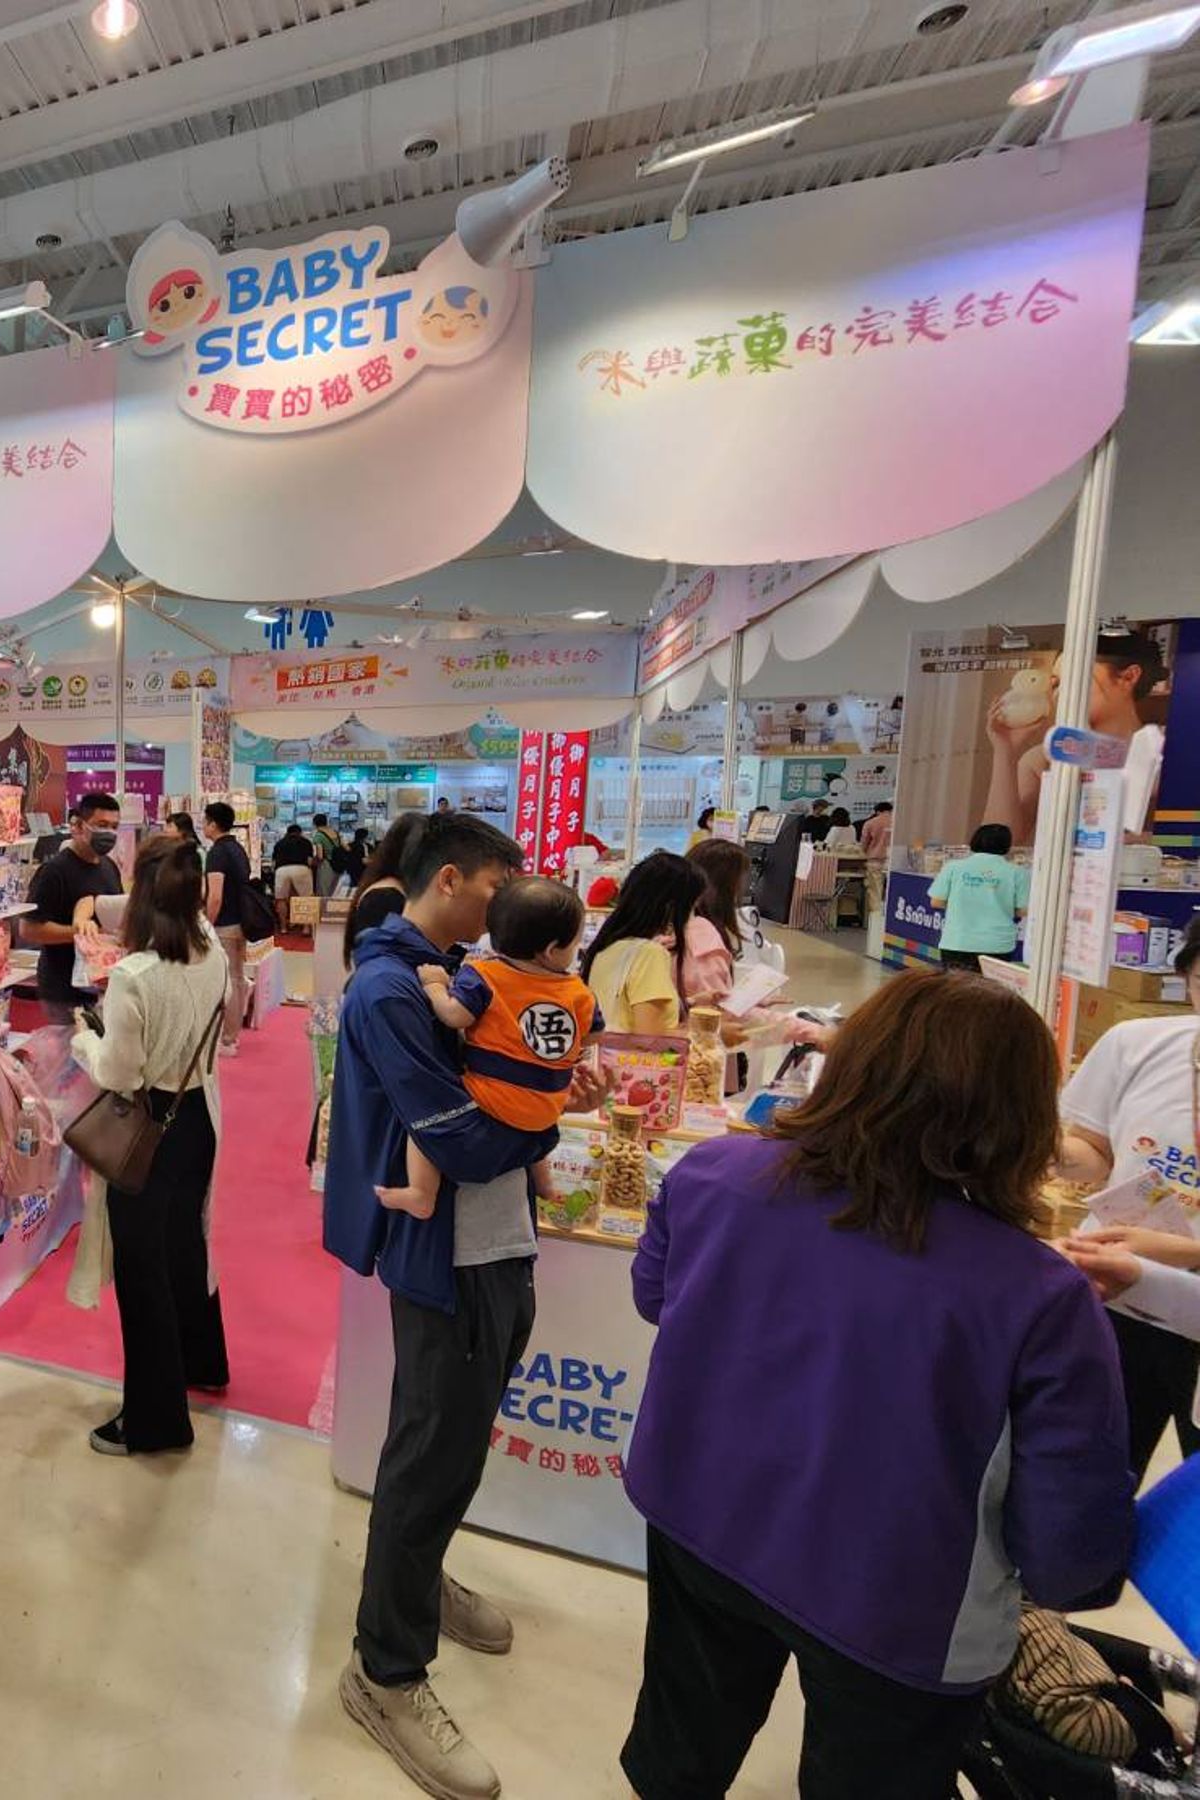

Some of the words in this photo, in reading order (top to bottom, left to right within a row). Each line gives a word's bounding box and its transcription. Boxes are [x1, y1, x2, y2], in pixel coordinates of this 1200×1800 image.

[227, 240, 380, 316] BABY
[197, 289, 412, 375] SECRET
[204, 355, 395, 420] 寶寶的秘密
[527, 1008, 572, 1055] 悟
